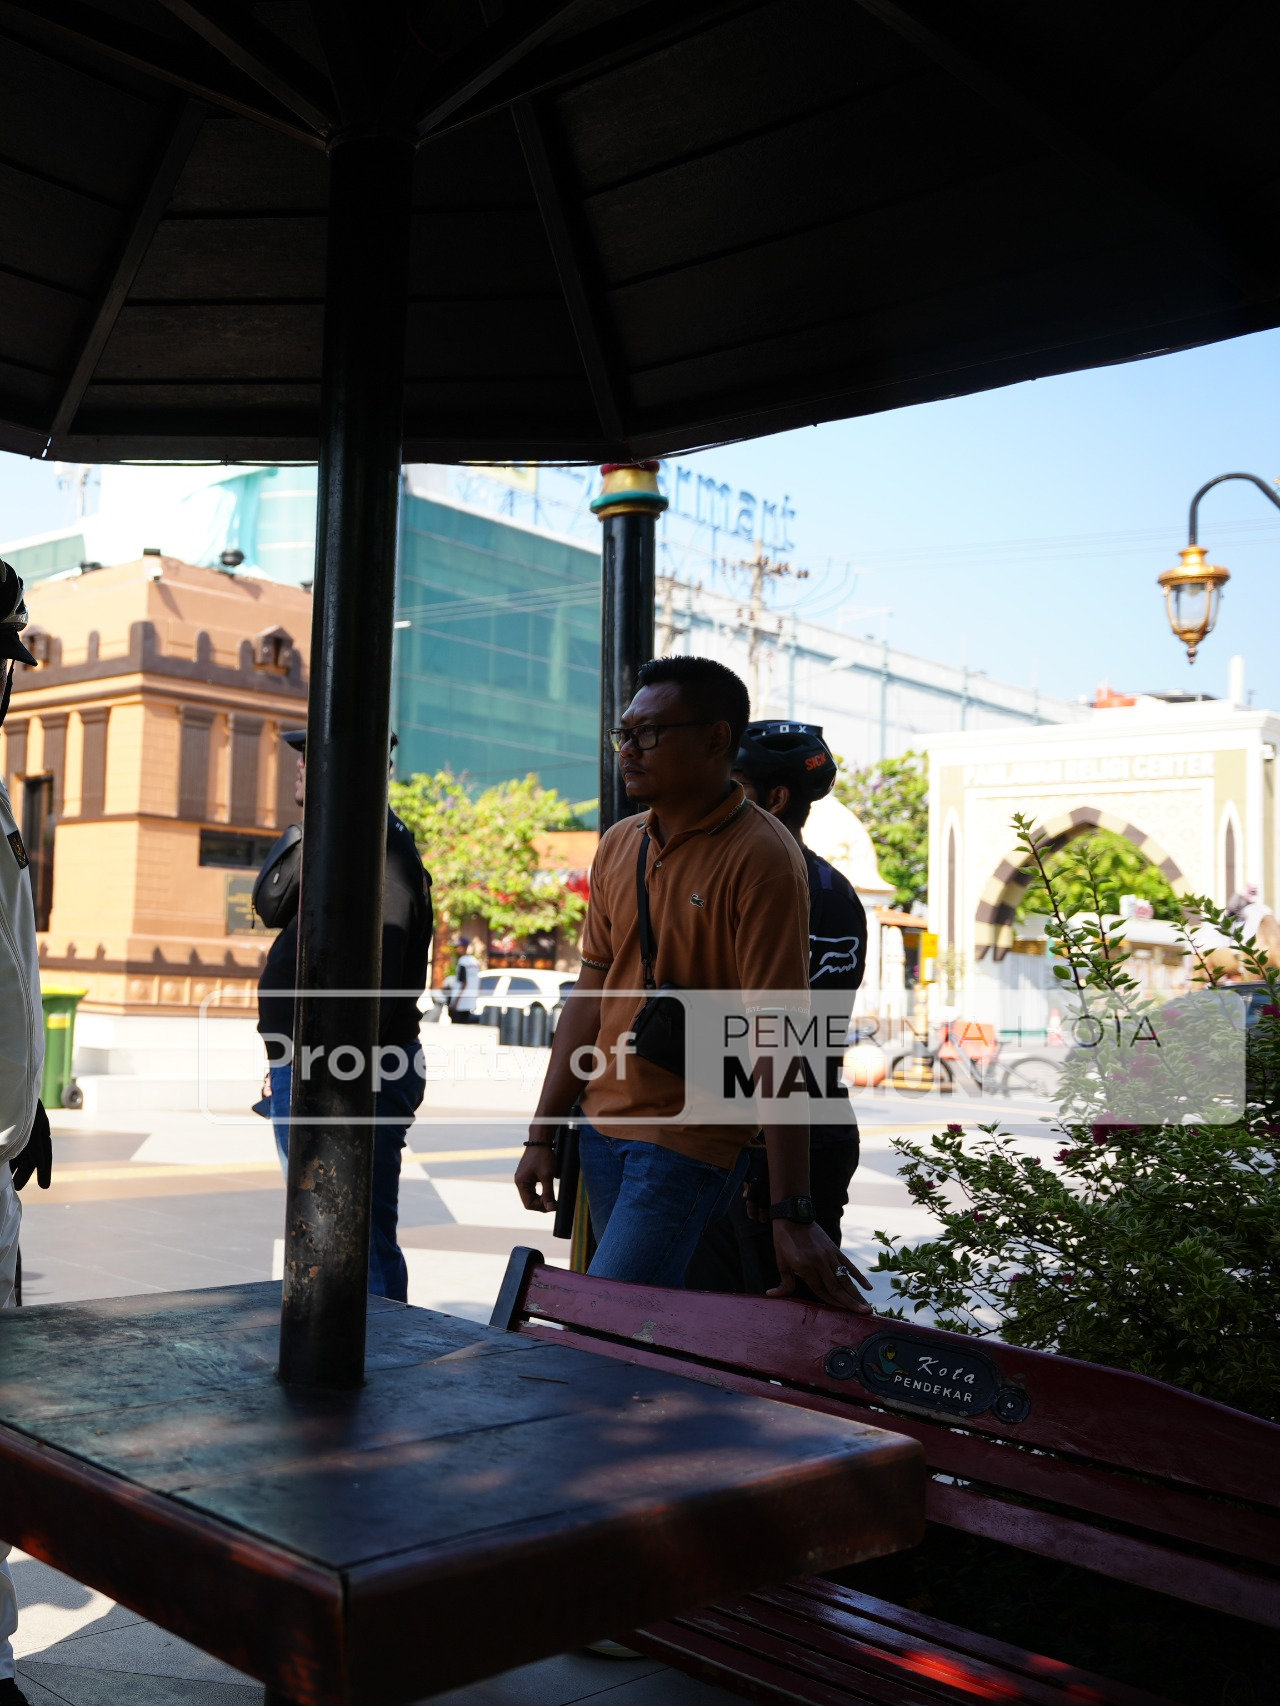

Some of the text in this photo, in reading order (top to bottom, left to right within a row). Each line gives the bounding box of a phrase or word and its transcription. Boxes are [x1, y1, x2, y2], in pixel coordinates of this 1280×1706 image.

[805, 752, 827, 771] SICK
[1132, 752, 1215, 777] CENTER
[917, 1356, 976, 1384] Kota
[894, 1375, 973, 1403] PENDEKAR
